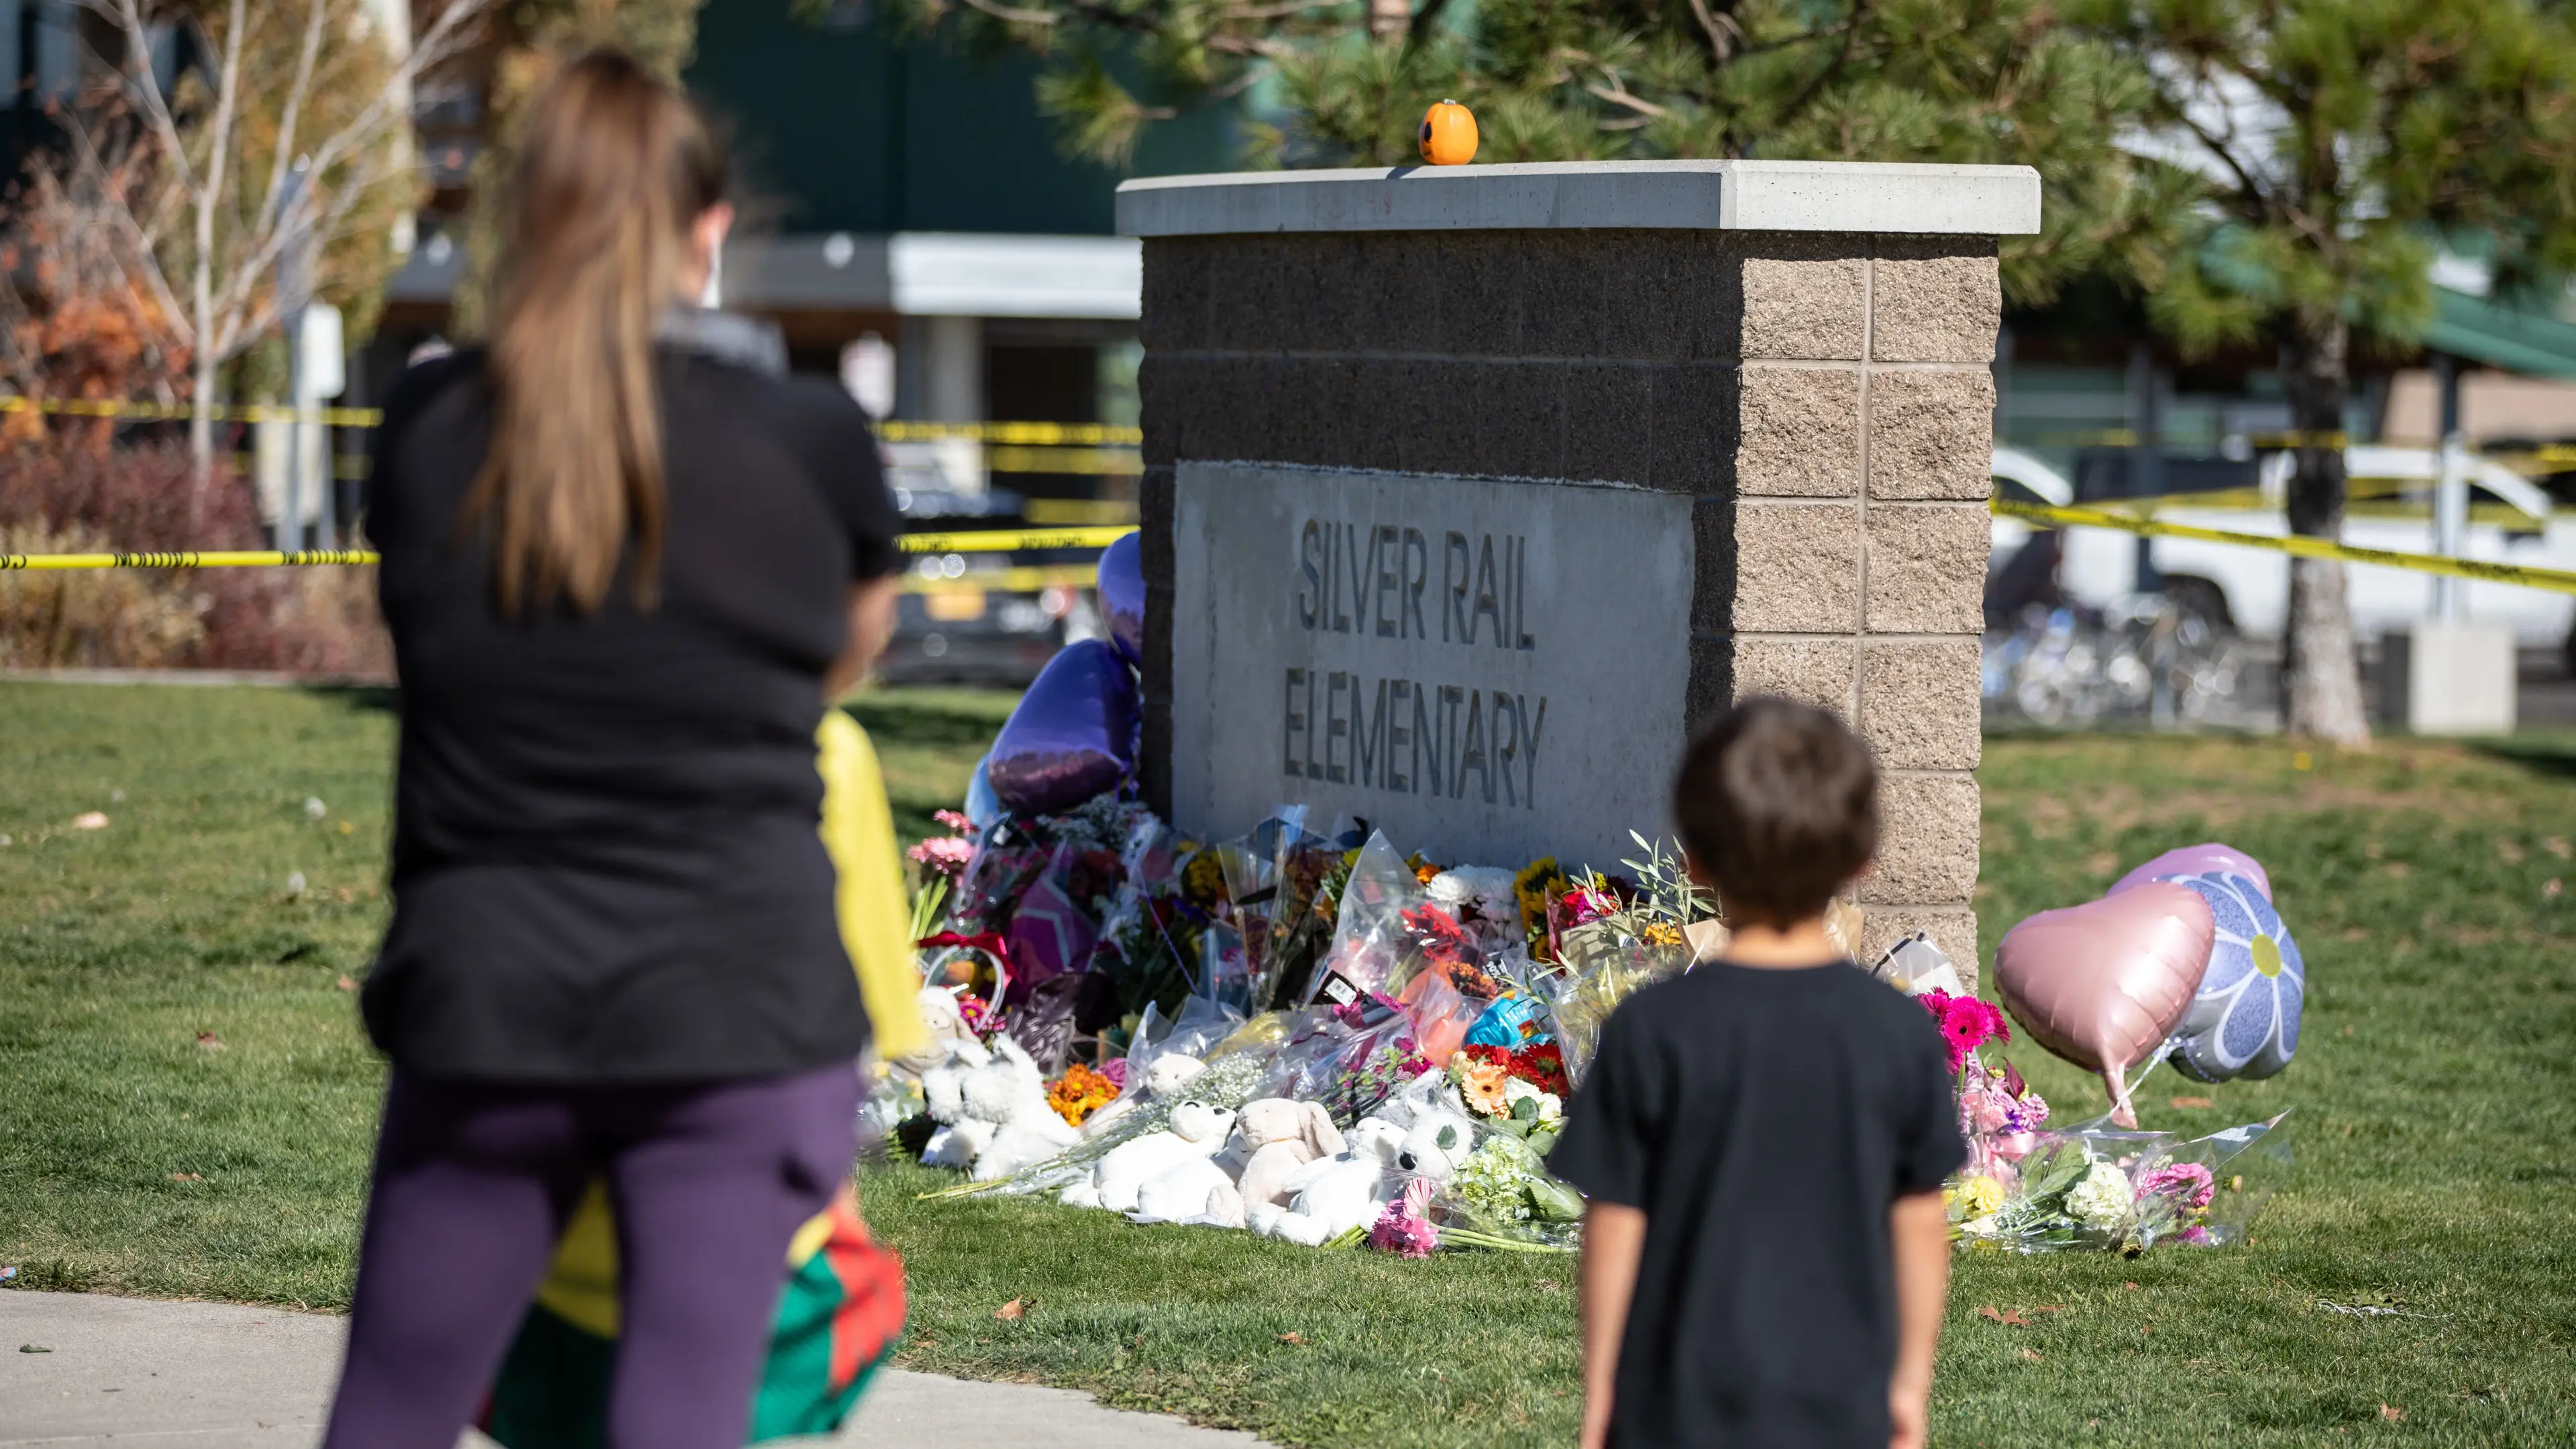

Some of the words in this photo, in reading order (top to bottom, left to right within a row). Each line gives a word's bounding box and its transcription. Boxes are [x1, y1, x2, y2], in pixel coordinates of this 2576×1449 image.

[1301, 519, 1427, 640] SILVER
[1442, 530, 1536, 650] RAIL
[1284, 667, 1547, 809] ELEMENTARY
